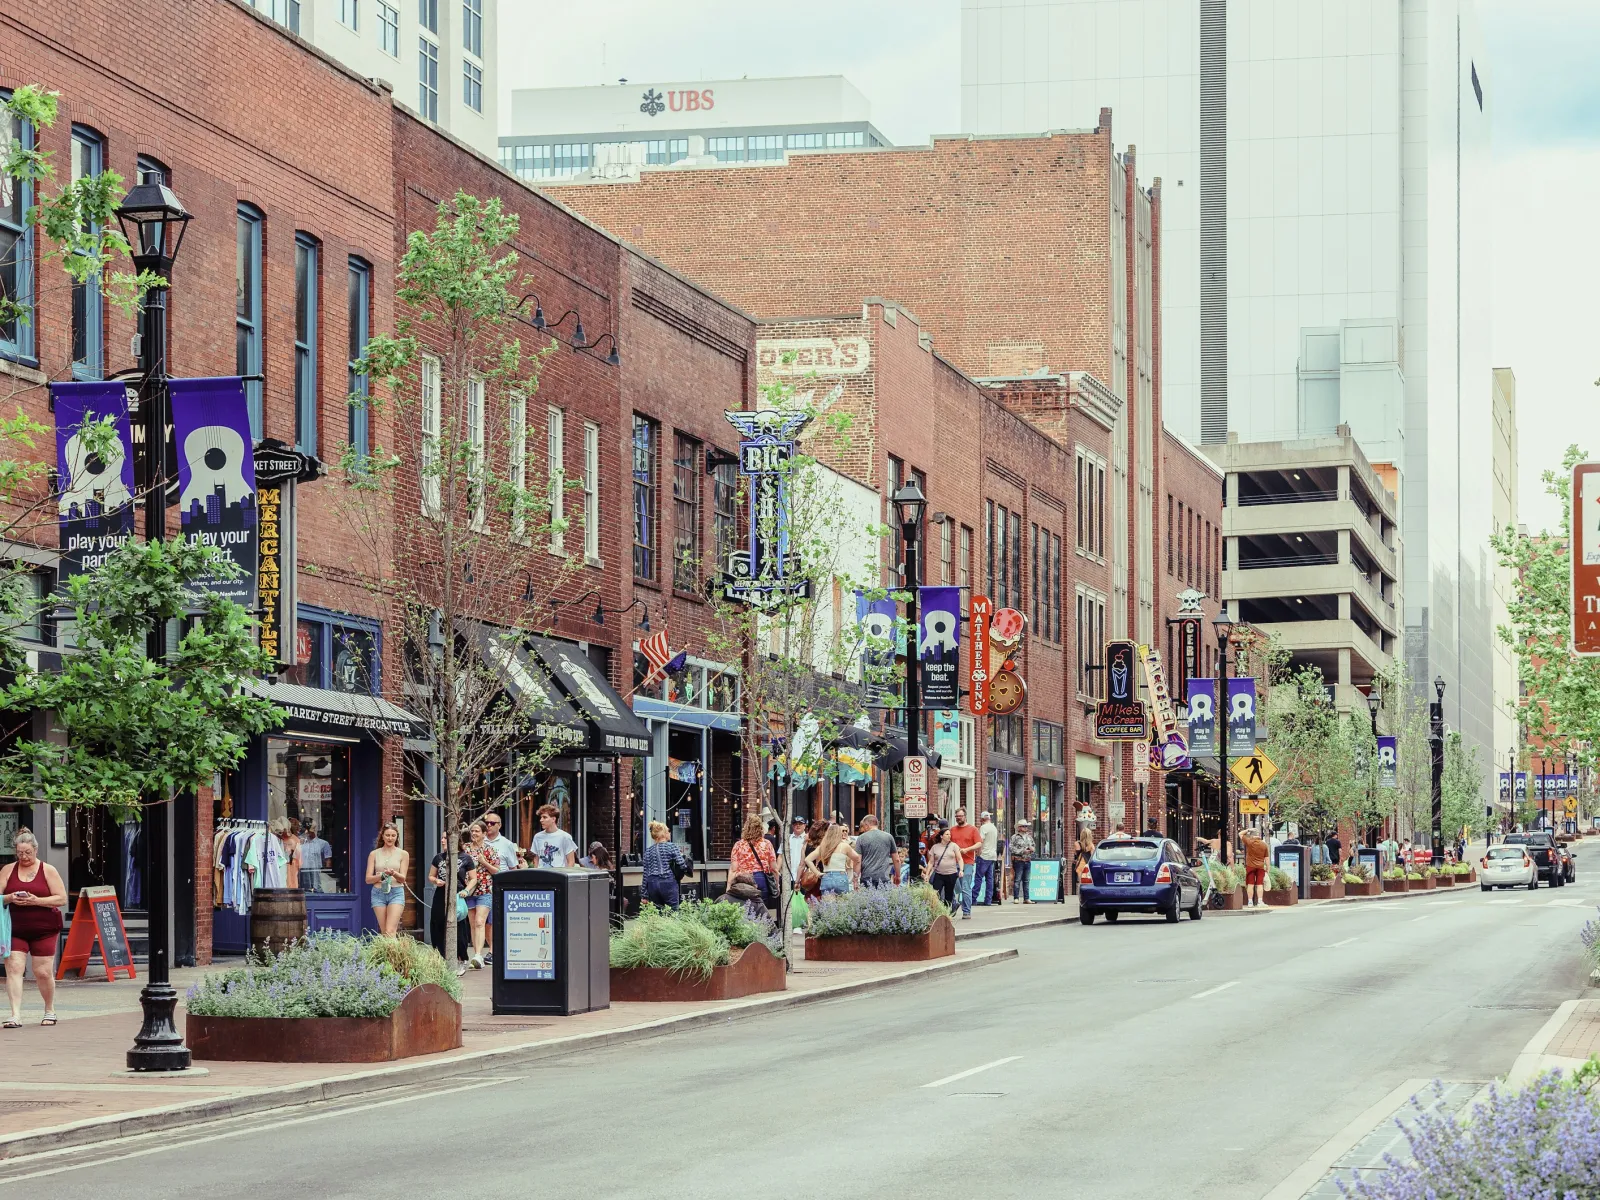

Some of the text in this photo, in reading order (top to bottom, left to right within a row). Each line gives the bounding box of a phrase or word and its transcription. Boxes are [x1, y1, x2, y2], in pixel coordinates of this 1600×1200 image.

[667, 89, 715, 112] UBS
[269, 459, 298, 471] STREET
[68, 533, 127, 552] play your
[220, 530, 250, 547] your
[257, 488, 281, 657] MERCANTILE
[232, 578, 244, 586] city.
[925, 662, 955, 673] keep the
[931, 672, 949, 682] beat.
[1101, 703, 1140, 716] Mike's
[286, 705, 412, 734] MARKET STREET MERCANTILE
[1098, 715, 1143, 725] Ice Cream
[508, 893, 550, 901] NASHVILLE
